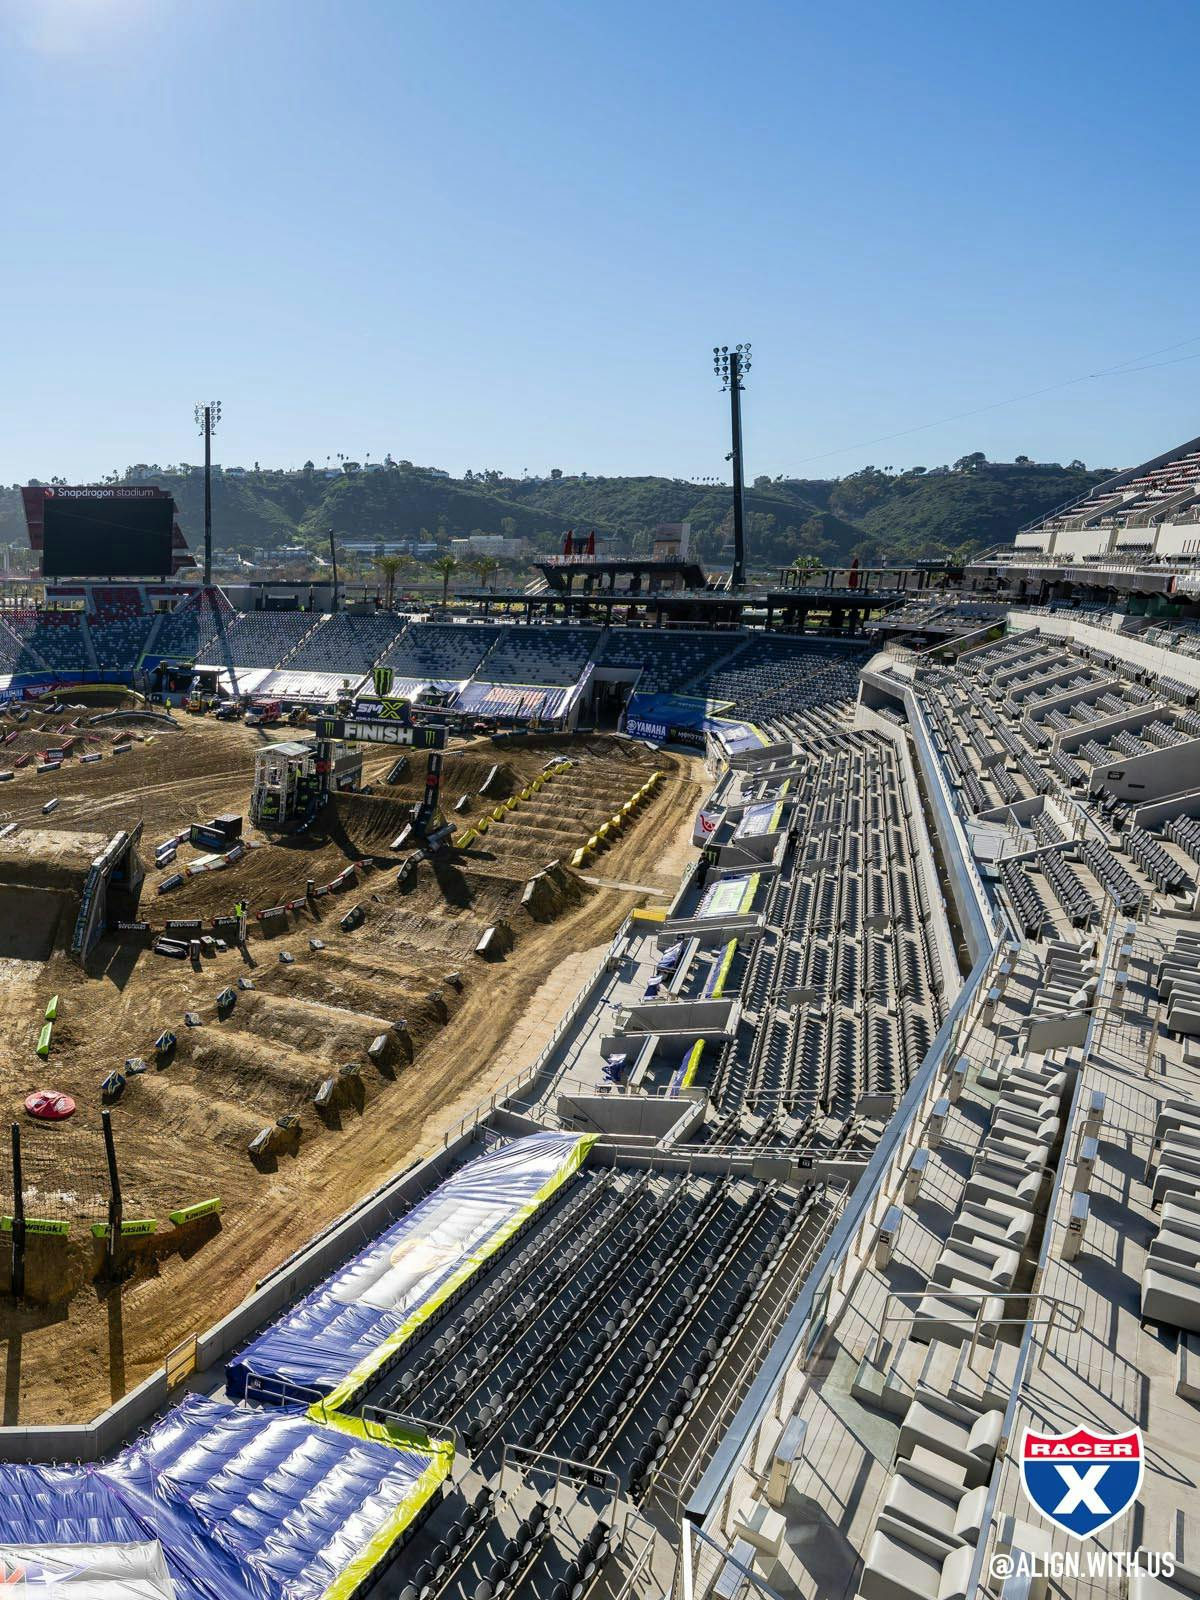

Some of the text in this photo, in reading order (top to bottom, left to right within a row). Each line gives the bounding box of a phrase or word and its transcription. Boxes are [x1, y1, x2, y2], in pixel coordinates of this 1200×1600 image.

[58, 488, 154, 499] Snapdragon stadium
[357, 701, 404, 720] SMX
[344, 722, 414, 744] FINISH
[636, 721, 666, 736] YAMAHA
[185, 1204, 216, 1221] Kawasaki
[12, 1222, 63, 1233] wasaki
